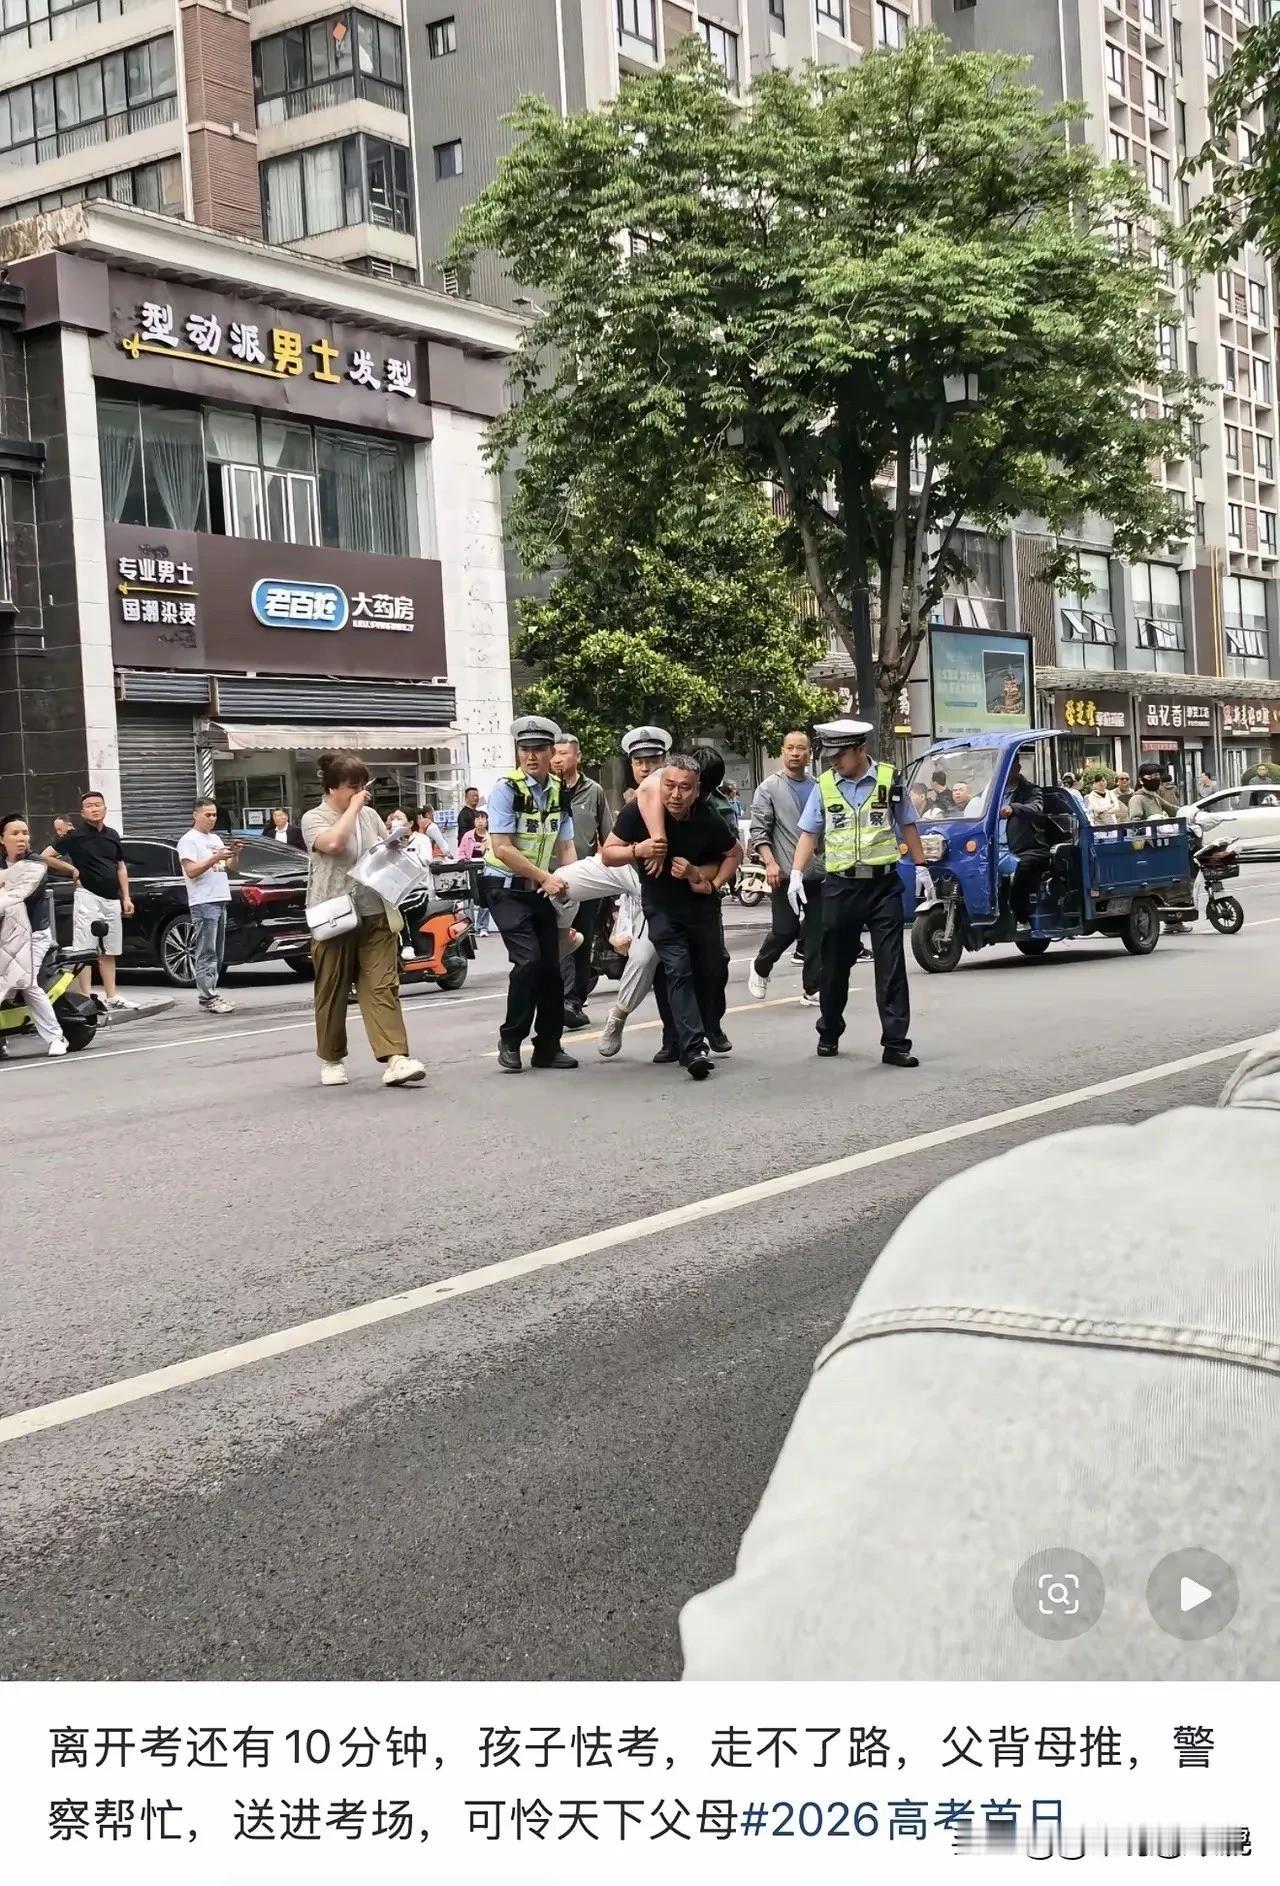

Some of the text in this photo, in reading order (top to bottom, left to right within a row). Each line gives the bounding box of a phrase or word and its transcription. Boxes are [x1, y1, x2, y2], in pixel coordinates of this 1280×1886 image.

[141, 302, 416, 397] 型动派男士发型
[118, 556, 194, 585] 专业男士
[351, 592, 415, 620] 大药房
